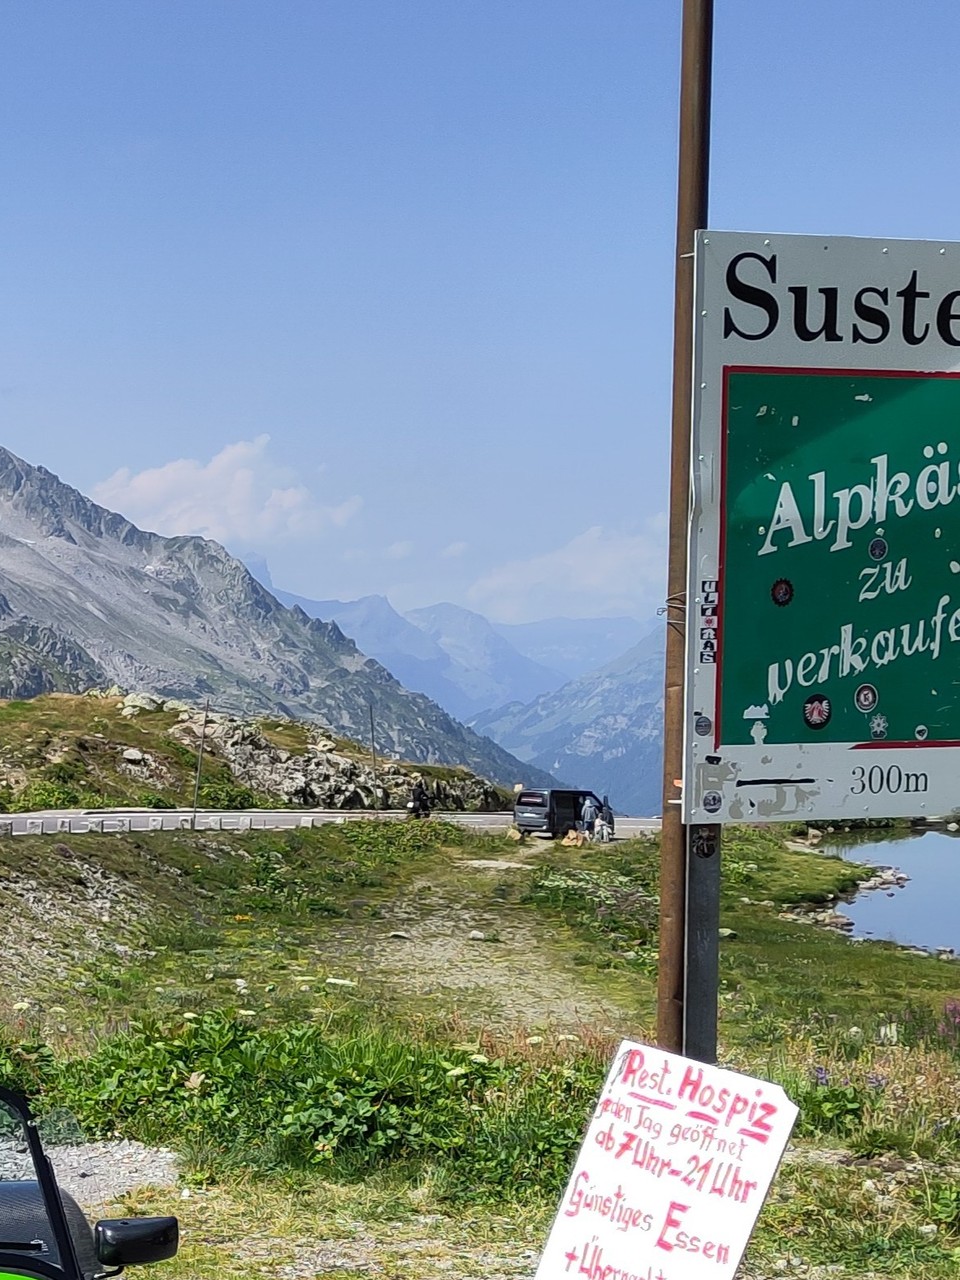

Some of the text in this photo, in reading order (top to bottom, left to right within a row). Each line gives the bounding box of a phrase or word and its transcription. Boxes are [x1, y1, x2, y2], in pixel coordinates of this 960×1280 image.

[757, 442, 960, 556] Alpkä
[859, 557, 912, 602] zu
[850, 764, 929, 796] 300m
[621, 1049, 778, 1132] Rest. Hospiz
[595, 1097, 748, 1161] jeden Tag geöffnet
[595, 1123, 616, 1151] ab
[655, 1201, 730, 1264] Essen
